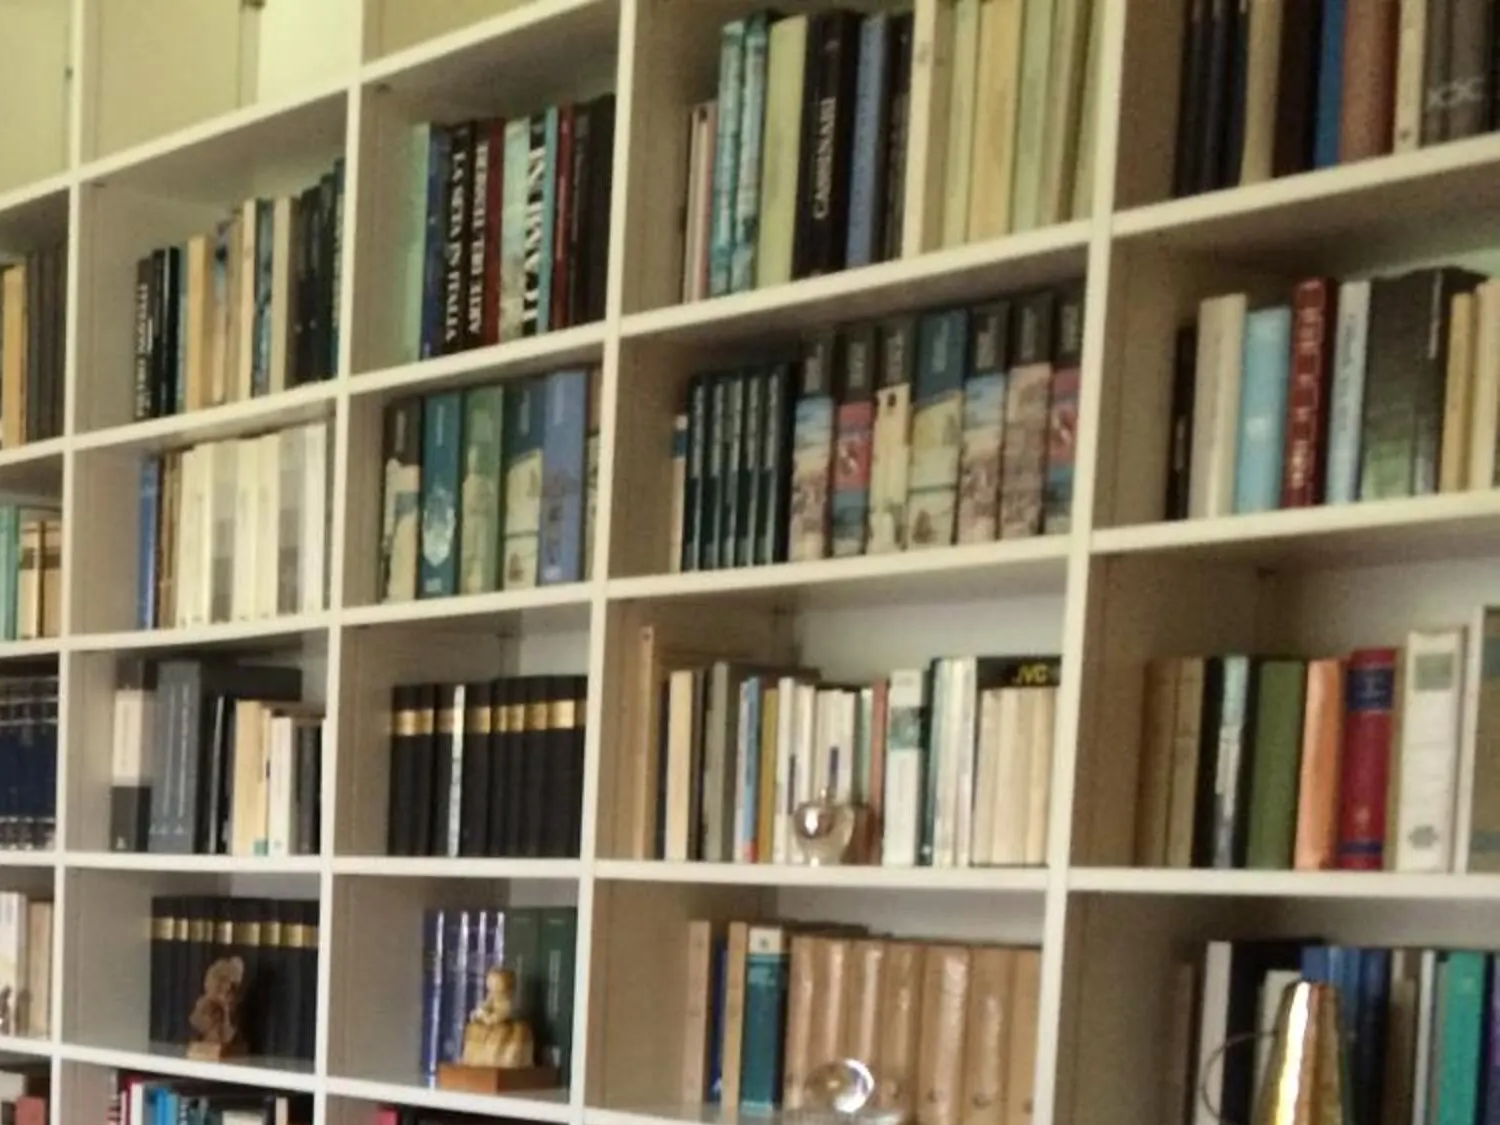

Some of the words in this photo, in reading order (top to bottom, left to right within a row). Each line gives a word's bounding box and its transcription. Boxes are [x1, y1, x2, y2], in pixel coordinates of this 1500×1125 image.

[452, 150, 466, 181] LA
[450, 184, 464, 238] SETA
[448, 241, 461, 268] IN
[445, 269, 460, 344] ITALIA
[1011, 663, 1048, 685] JVC
